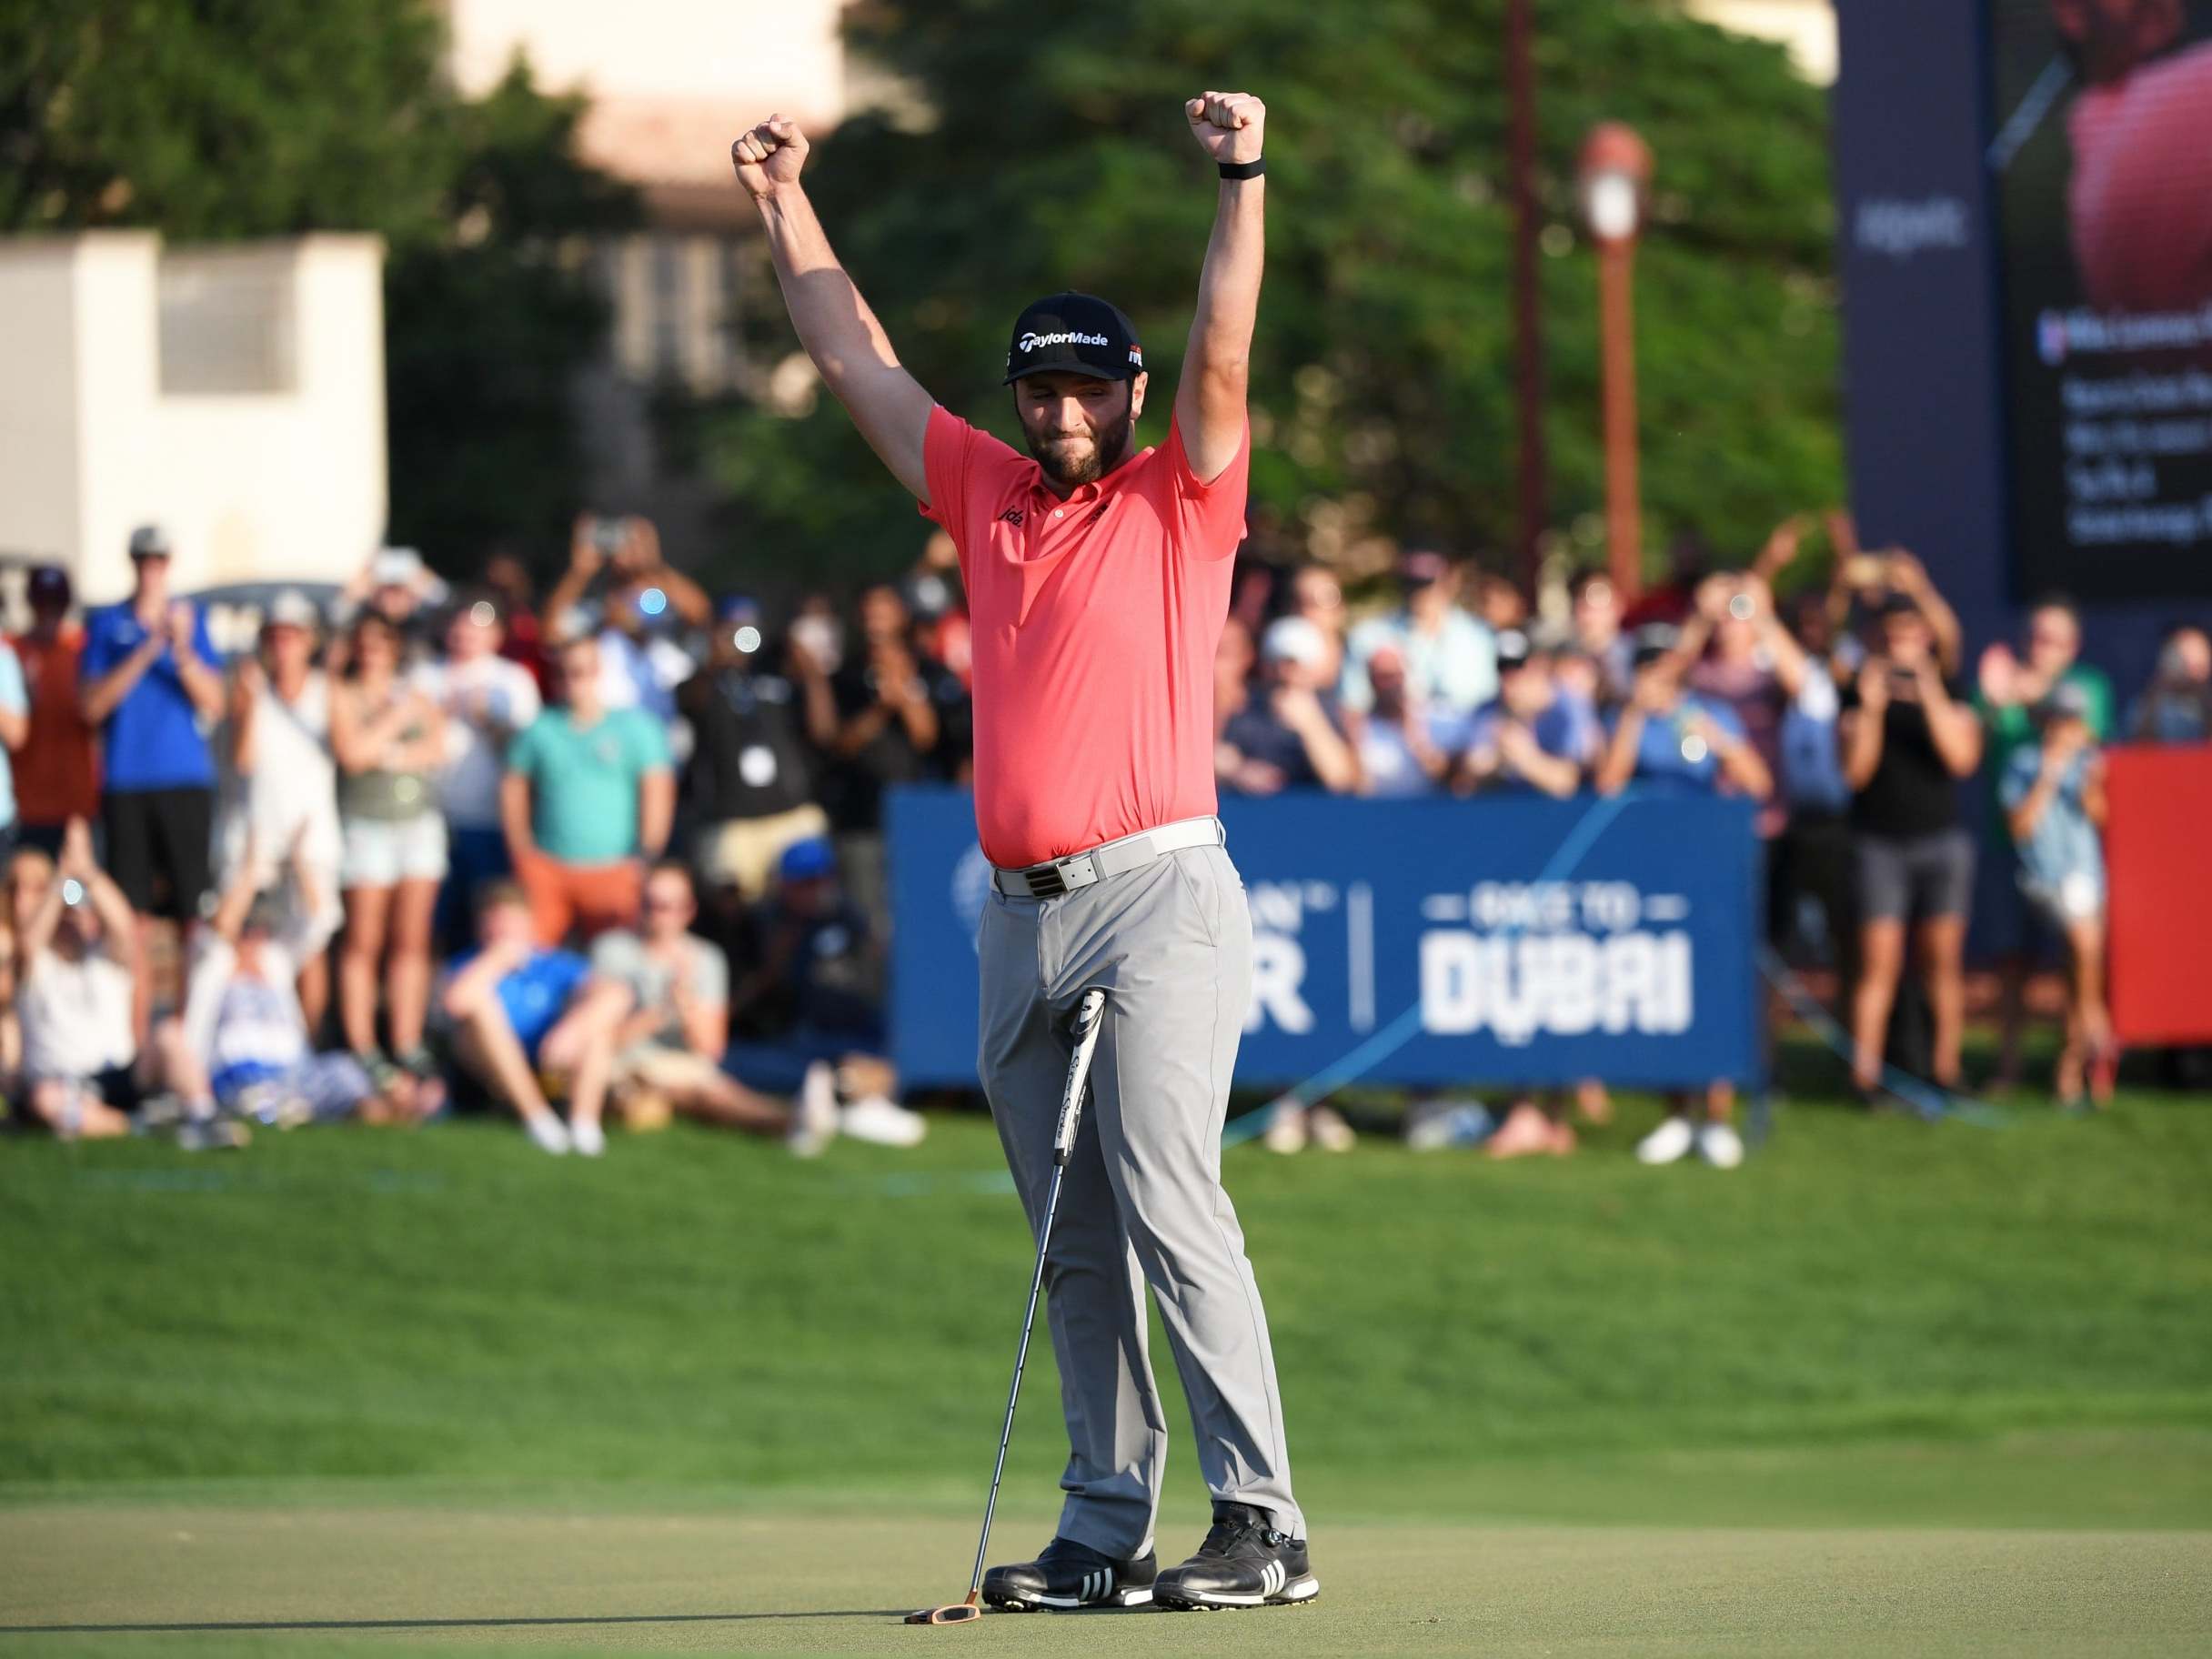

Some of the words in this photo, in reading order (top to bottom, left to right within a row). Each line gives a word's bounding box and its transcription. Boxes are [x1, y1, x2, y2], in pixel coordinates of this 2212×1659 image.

[1020, 332, 1108, 353] TaylorMade
[1581, 881, 1640, 930] TO
[1420, 930, 1693, 1046] DUBAI
